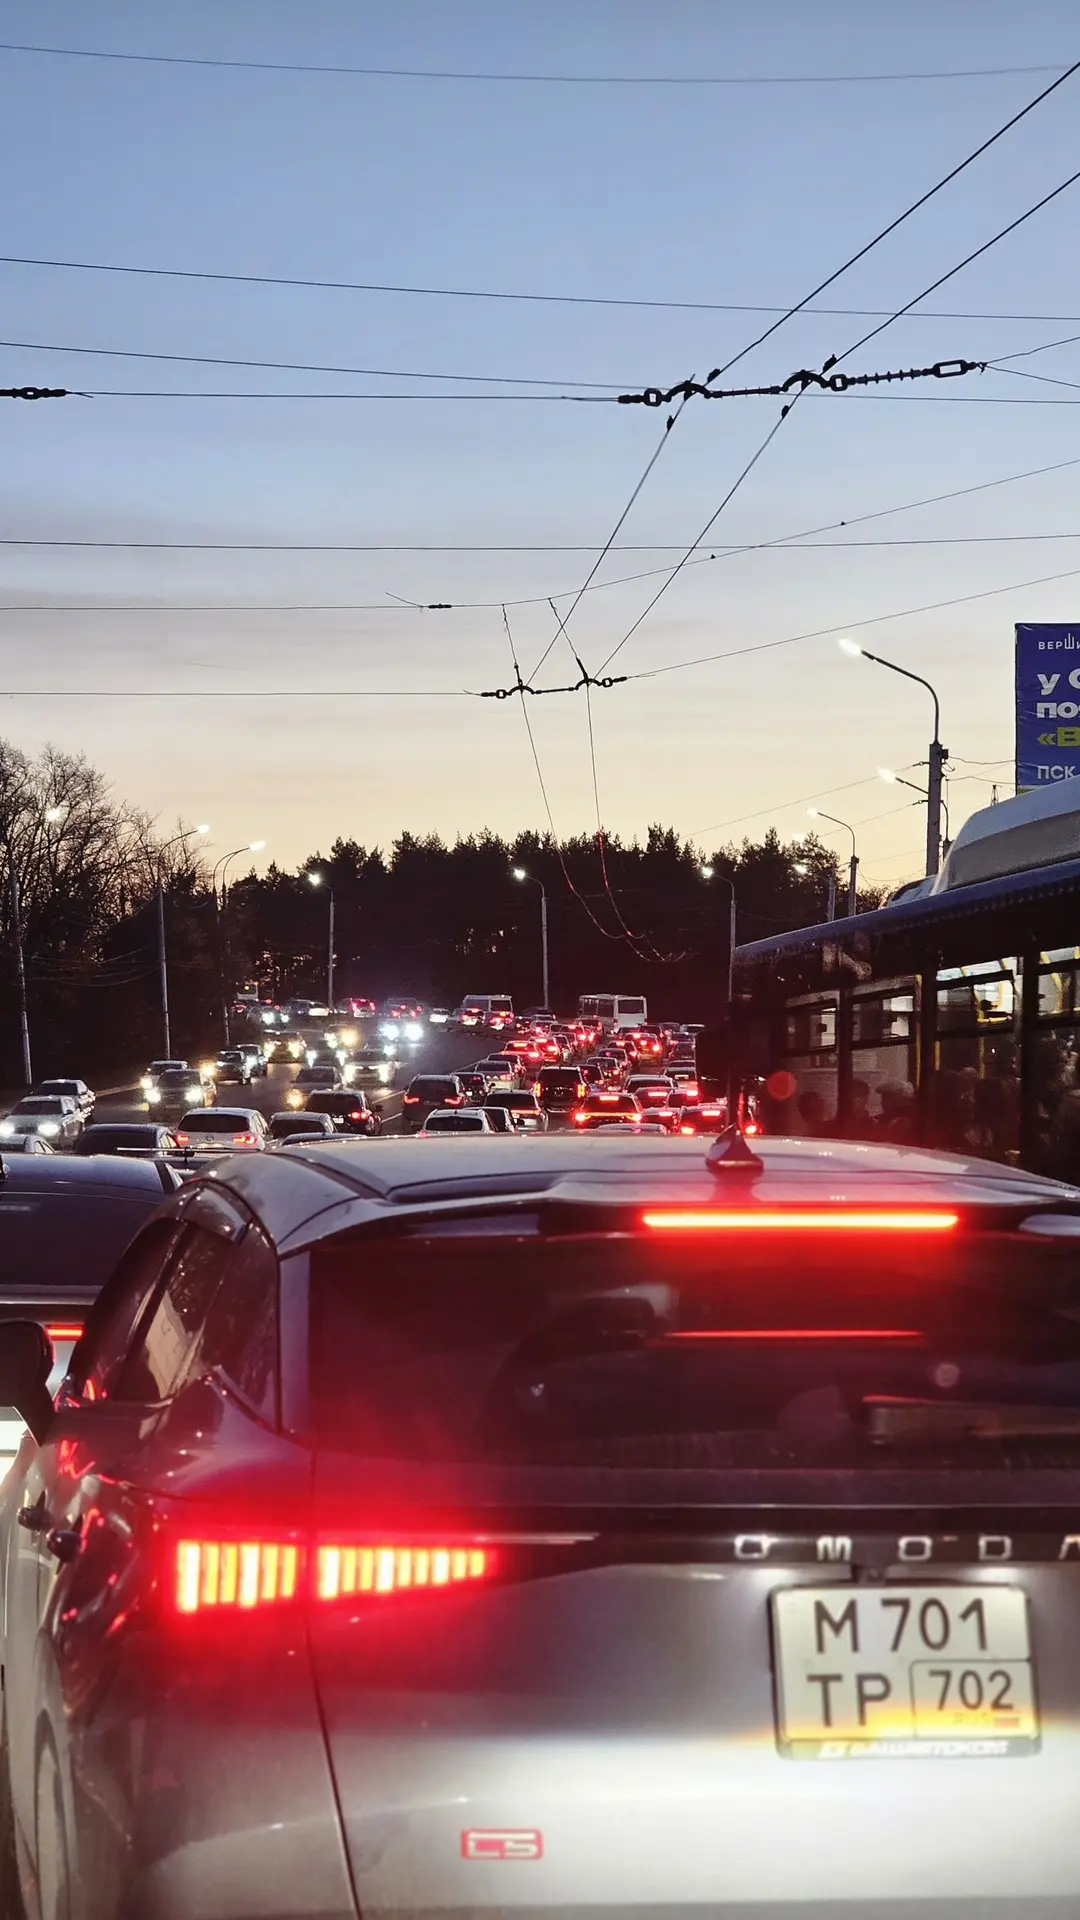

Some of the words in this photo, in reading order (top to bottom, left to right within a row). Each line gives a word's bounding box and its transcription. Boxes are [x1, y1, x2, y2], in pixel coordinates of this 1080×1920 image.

[1037, 701, 1080, 719] по
[1037, 765, 1076, 780] ПСК
[881, 1597, 988, 1652] 701
[929, 1669, 1014, 1711] 702
